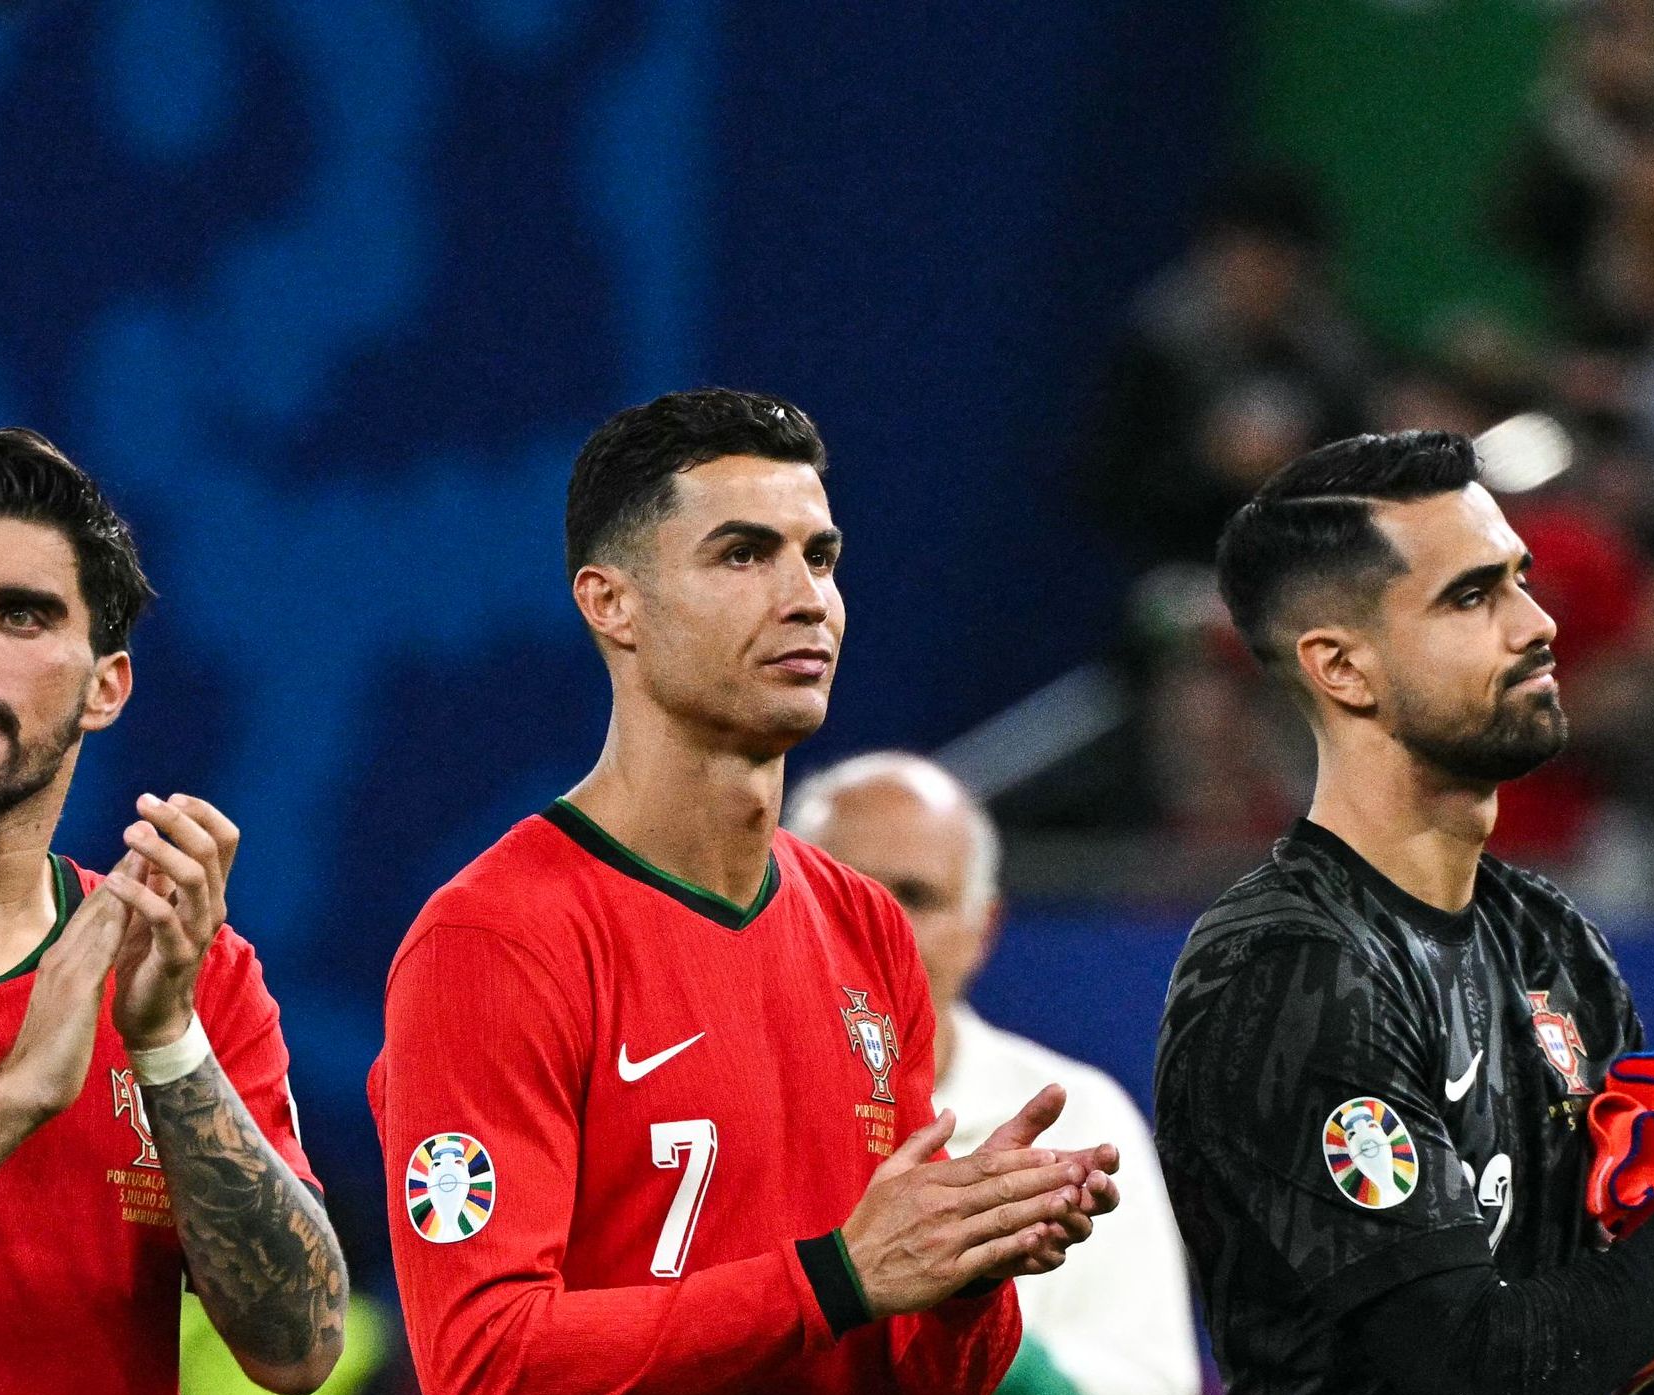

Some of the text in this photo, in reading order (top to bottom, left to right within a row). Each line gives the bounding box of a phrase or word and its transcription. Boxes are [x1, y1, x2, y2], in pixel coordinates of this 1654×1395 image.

[107, 1169, 166, 1191] PORTUGAL/F
[119, 1188, 125, 1203] 5
[650, 1119, 718, 1278] 7
[1461, 1153, 1513, 1257] 2
